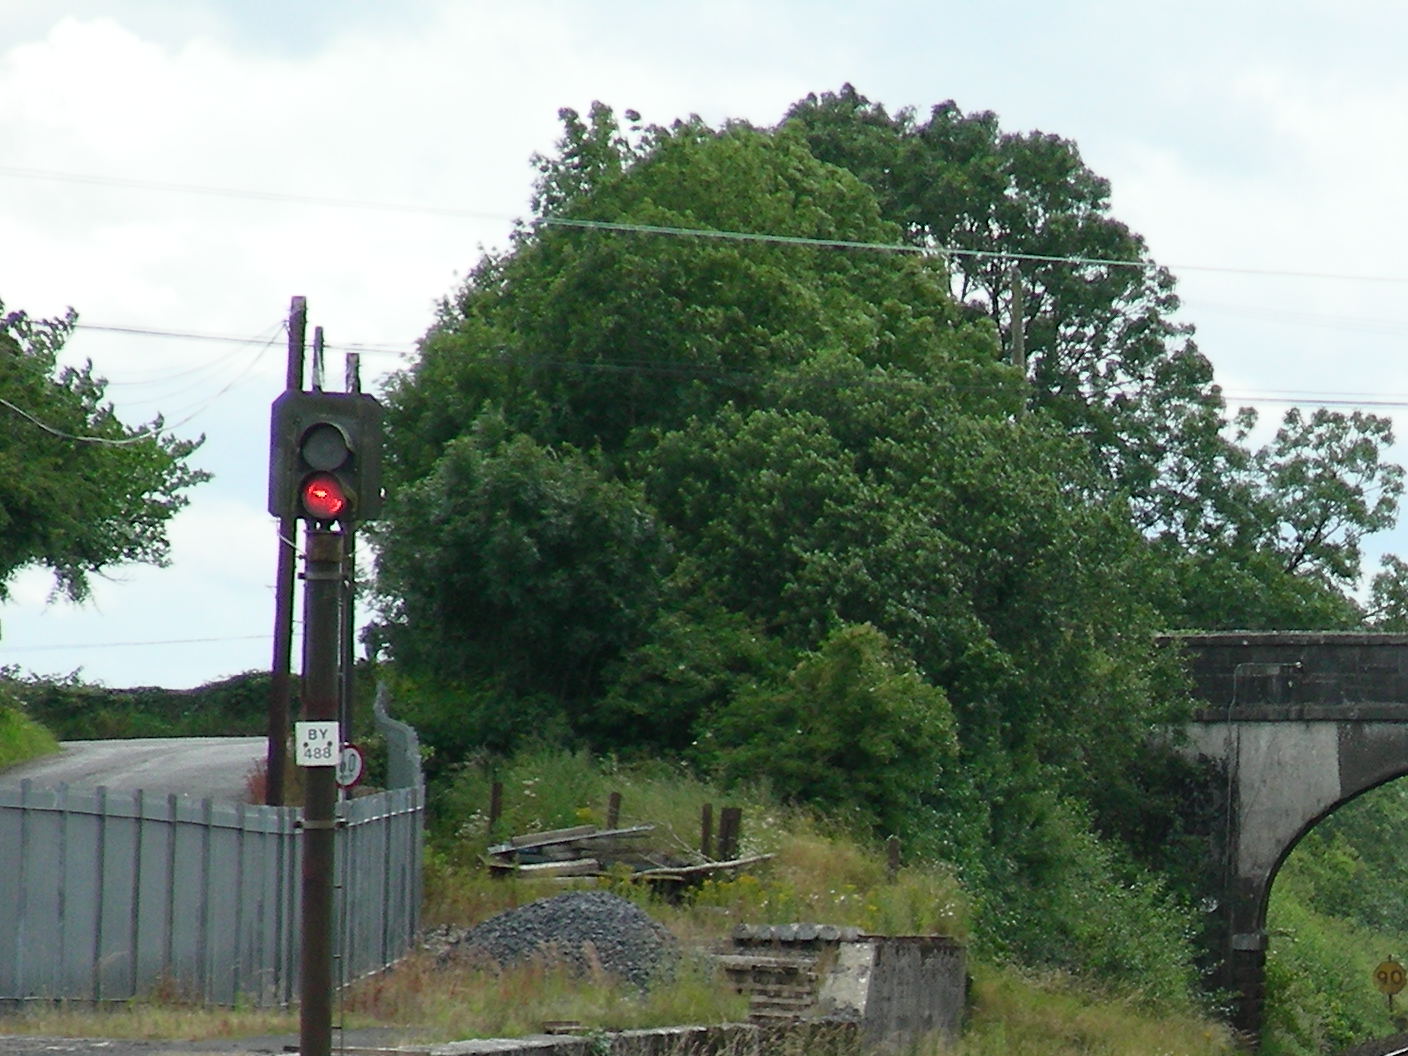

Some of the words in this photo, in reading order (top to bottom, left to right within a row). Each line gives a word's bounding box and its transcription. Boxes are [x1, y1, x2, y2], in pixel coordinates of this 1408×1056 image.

[308, 728, 328, 741] BY
[304, 747, 332, 759] 488
[1377, 970, 1402, 985] 90
